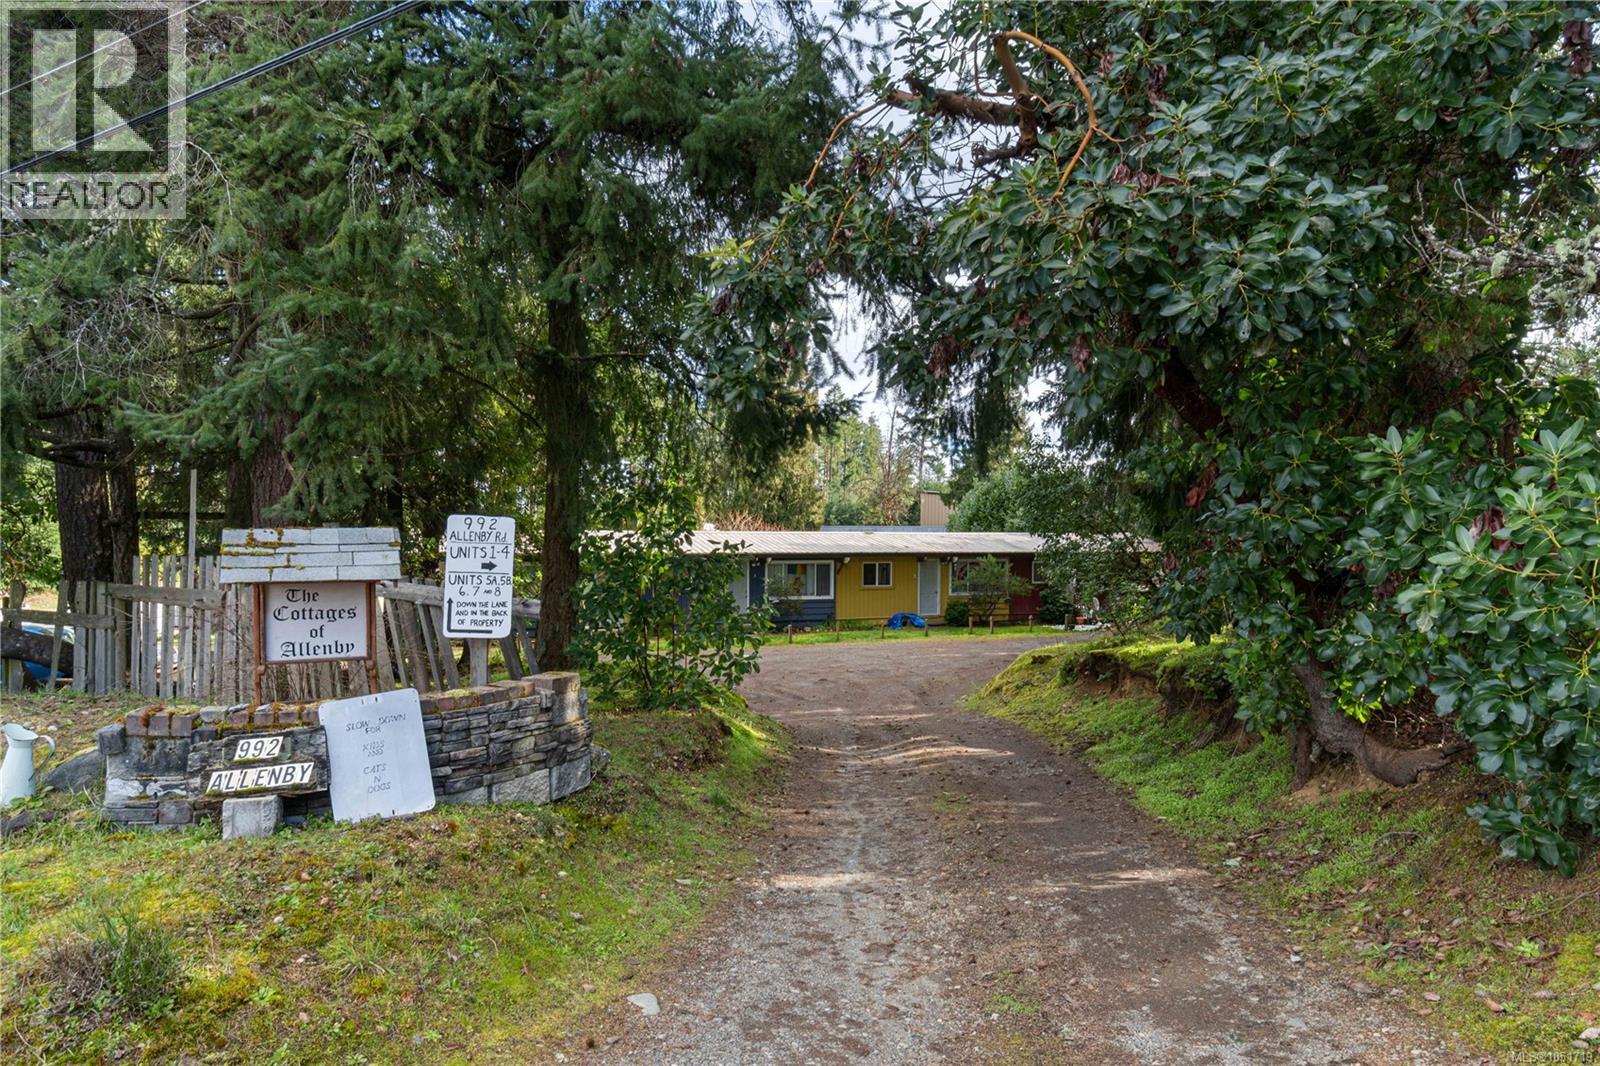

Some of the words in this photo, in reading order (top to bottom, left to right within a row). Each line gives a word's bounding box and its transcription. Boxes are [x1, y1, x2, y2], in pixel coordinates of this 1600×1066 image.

[464, 517, 498, 530] 992
[449, 531, 493, 542] ALLENBY
[494, 531, 507, 542] Rd
[450, 546, 487, 559] UNITS
[489, 545, 511, 559] 1-4
[448, 574, 482, 586] UNITS
[286, 588, 320, 603] The
[472, 585, 480, 597] 7
[494, 586, 501, 597] 8
[491, 601, 509, 609] LANE
[272, 605, 358, 623] Cottages
[457, 618, 466, 626] OF
[470, 619, 504, 628] PROPERTY
[309, 625, 325, 639] of
[280, 640, 355, 659] Allenby
[345, 720, 371, 733] SLOW
[378, 712, 408, 726] DOWN
[364, 725, 382, 735] FOR
[237, 738, 280, 760] 992
[362, 762, 388, 775] CATS
[209, 763, 312, 791] ALLENBY
[373, 775, 382, 784] N
[367, 781, 392, 794] DOGS
